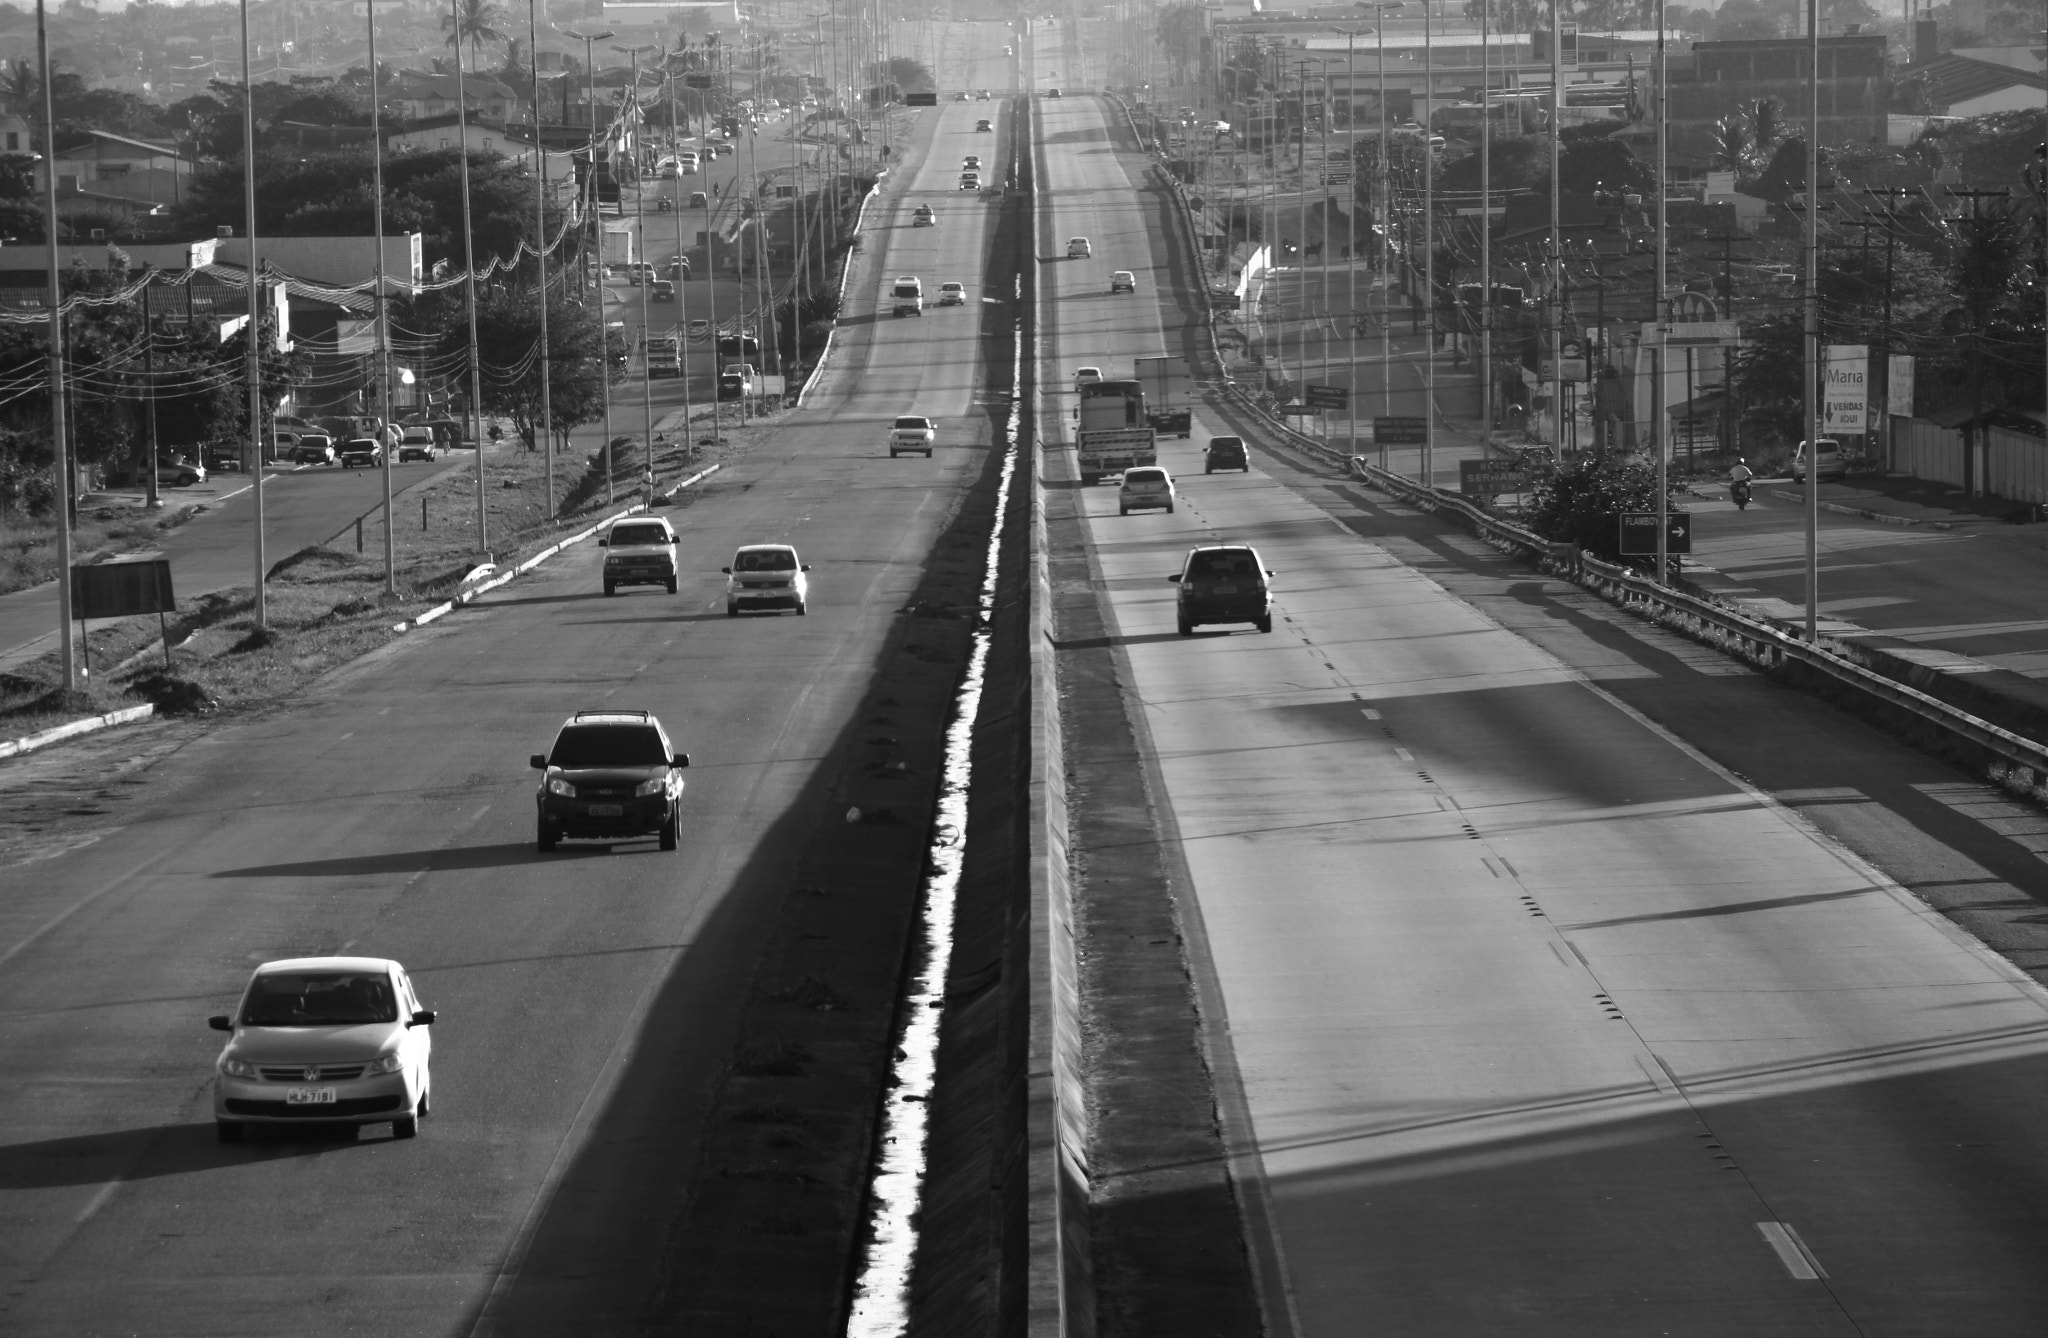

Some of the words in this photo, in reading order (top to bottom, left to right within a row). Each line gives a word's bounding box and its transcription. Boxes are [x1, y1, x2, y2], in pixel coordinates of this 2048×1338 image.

[1827, 369, 1863, 384] Maria
[1833, 402, 1864, 412] VENDAS
[1840, 414, 1858, 423] AQUI
[1625, 516, 1672, 526] FLAMBOYT
